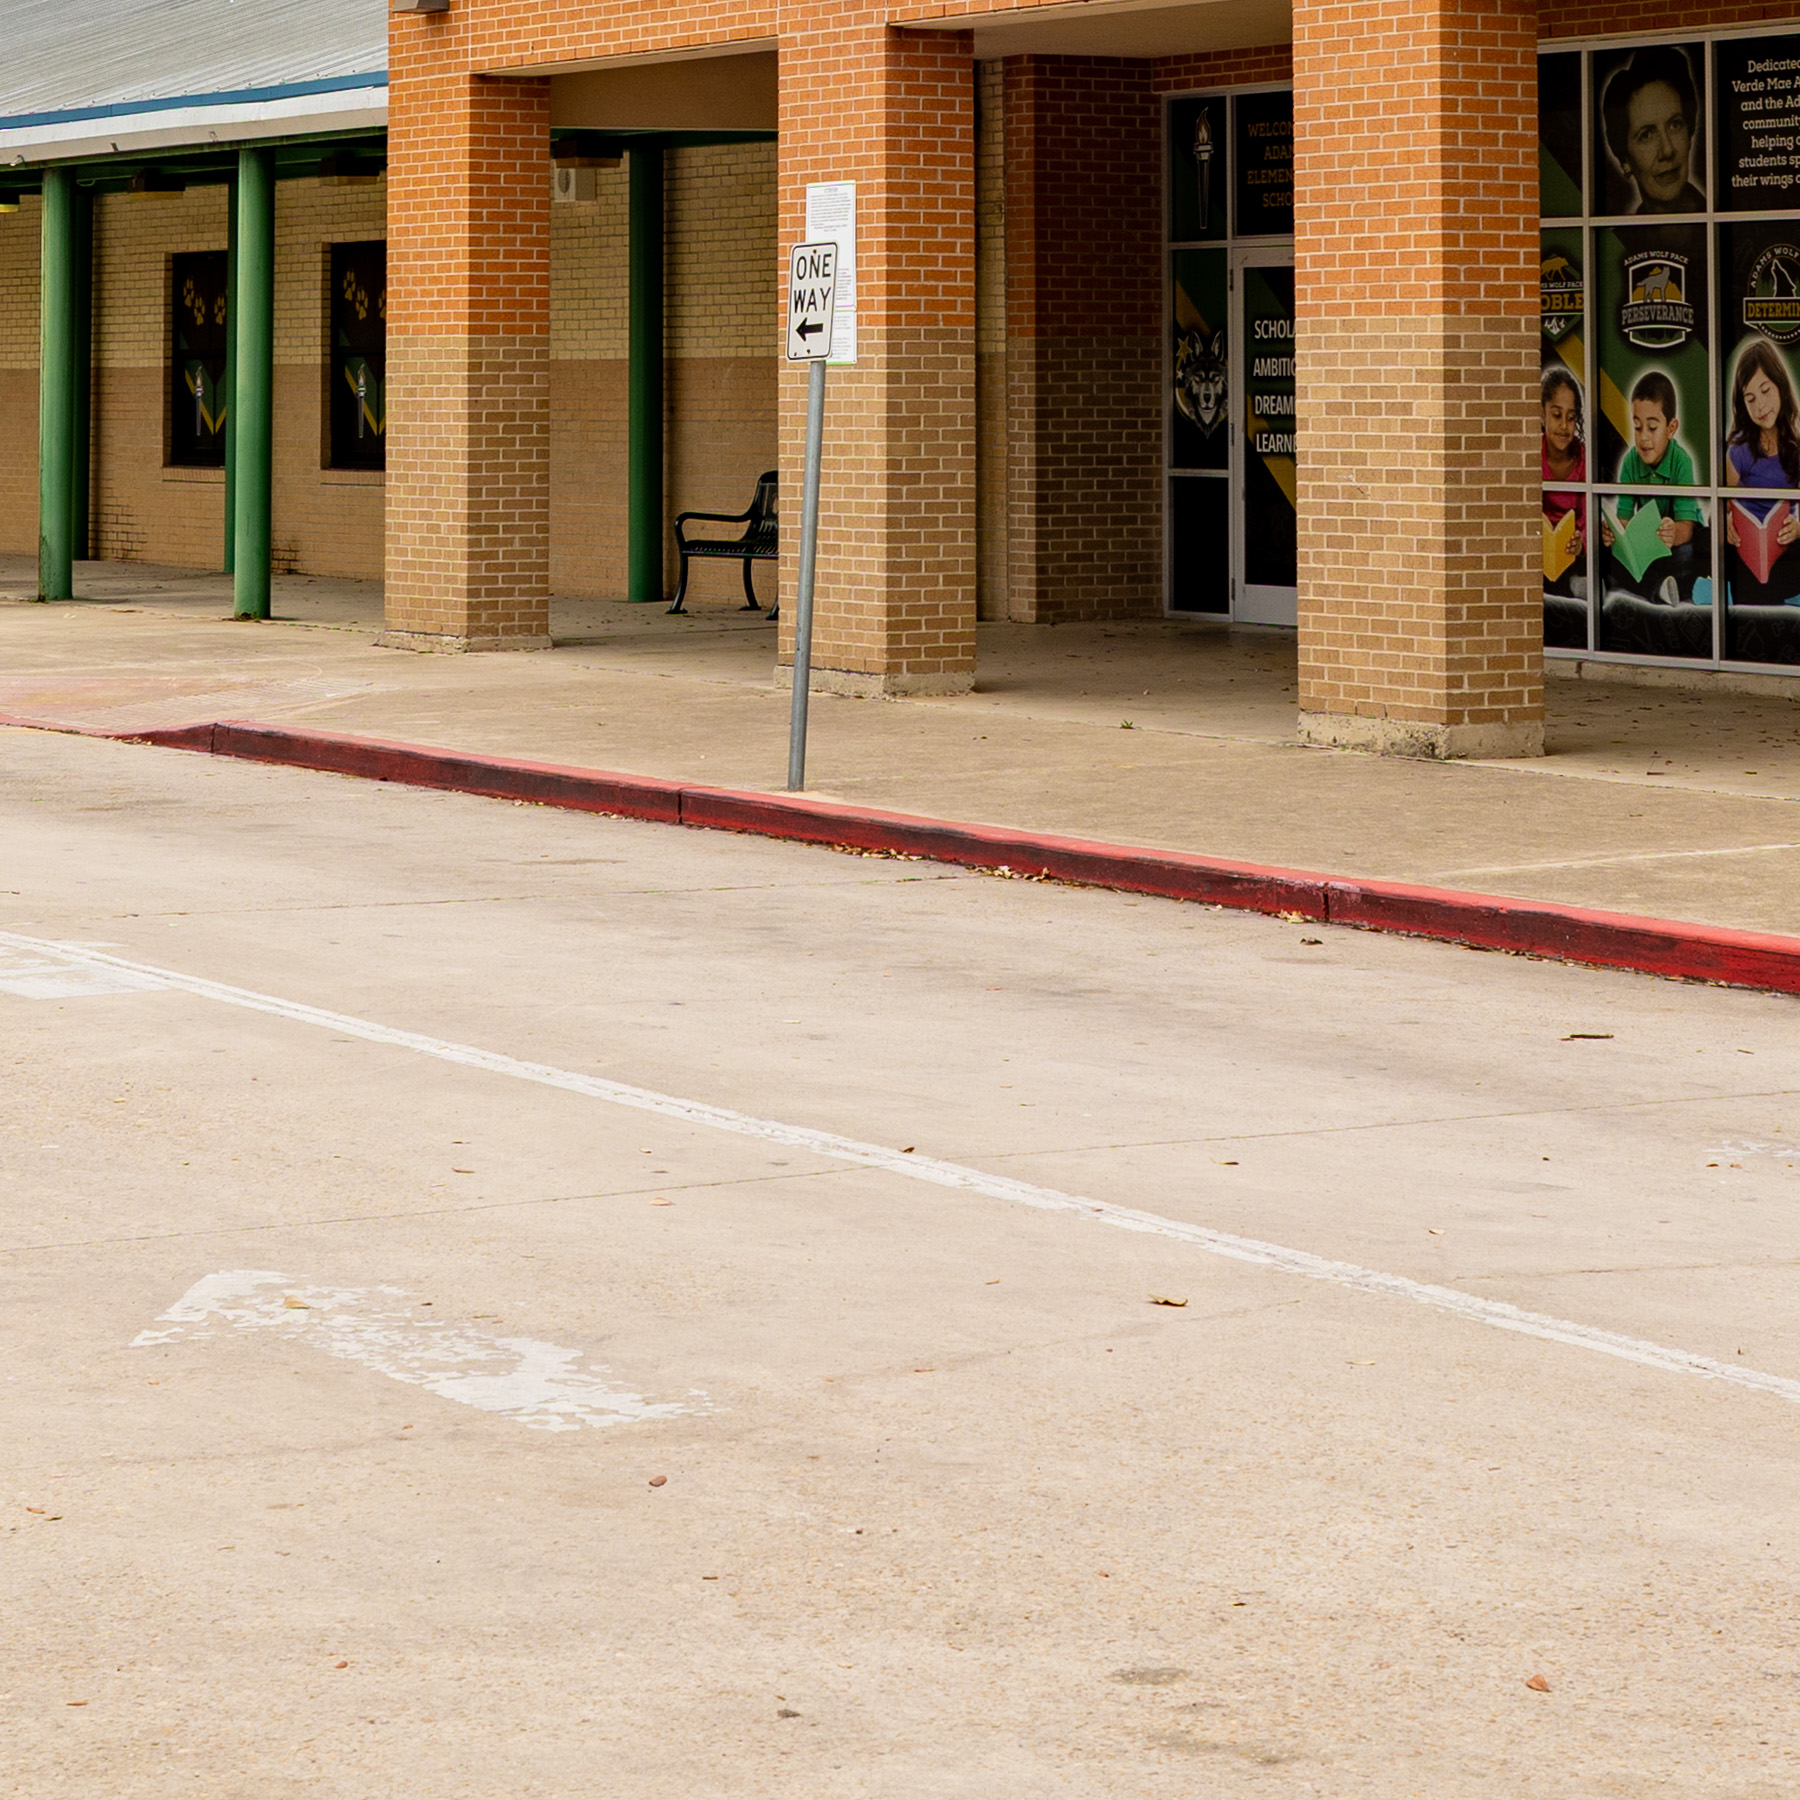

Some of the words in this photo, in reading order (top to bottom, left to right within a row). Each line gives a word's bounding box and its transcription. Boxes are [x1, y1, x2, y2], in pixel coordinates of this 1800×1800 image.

[1731, 79, 1765, 93] Verde
[1767, 77, 1792, 91] Mae
[1740, 97, 1763, 111] and
[1765, 96, 1784, 109] the
[1751, 134, 1794, 150] helping
[1738, 154, 1788, 168] students
[1731, 173, 1759, 188] their
[1760, 172, 1794, 189] wings
[1774, 246, 1800, 259] WOLF
[796, 253, 832, 280] ONE
[793, 286, 832, 314] WAY
[1621, 304, 1695, 326] PERSEVERANCE
[1254, 395, 1296, 415] DREAM
